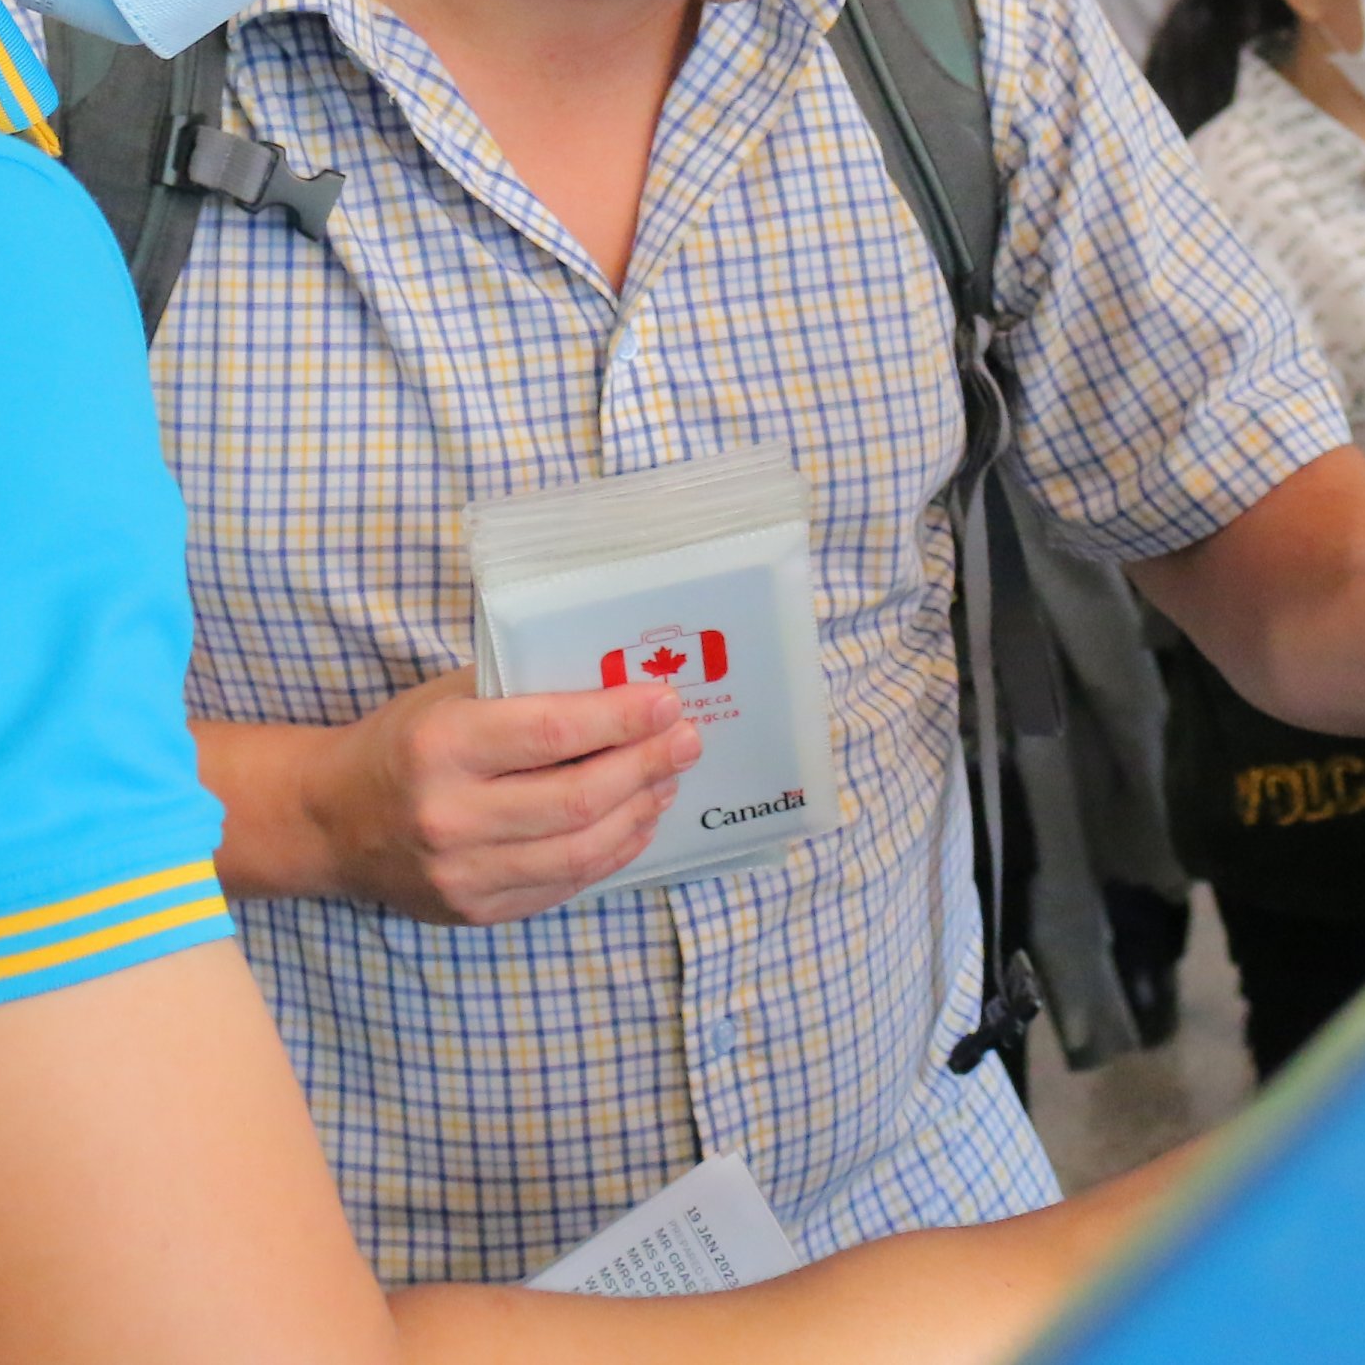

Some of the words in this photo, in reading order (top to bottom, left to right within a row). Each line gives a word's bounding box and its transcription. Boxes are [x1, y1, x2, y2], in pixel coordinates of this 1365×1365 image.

[700, 790, 806, 830] Canada
[626, 1247, 645, 1272] MR
[641, 1237, 658, 1260] MS
[654, 1227, 673, 1252] MR
[668, 1252, 699, 1294] GRAE
[686, 1206, 702, 1223] 19
[697, 1224, 720, 1254] JAN
[714, 1254, 740, 1288] 2023
[612, 1256, 637, 1290] MRS
